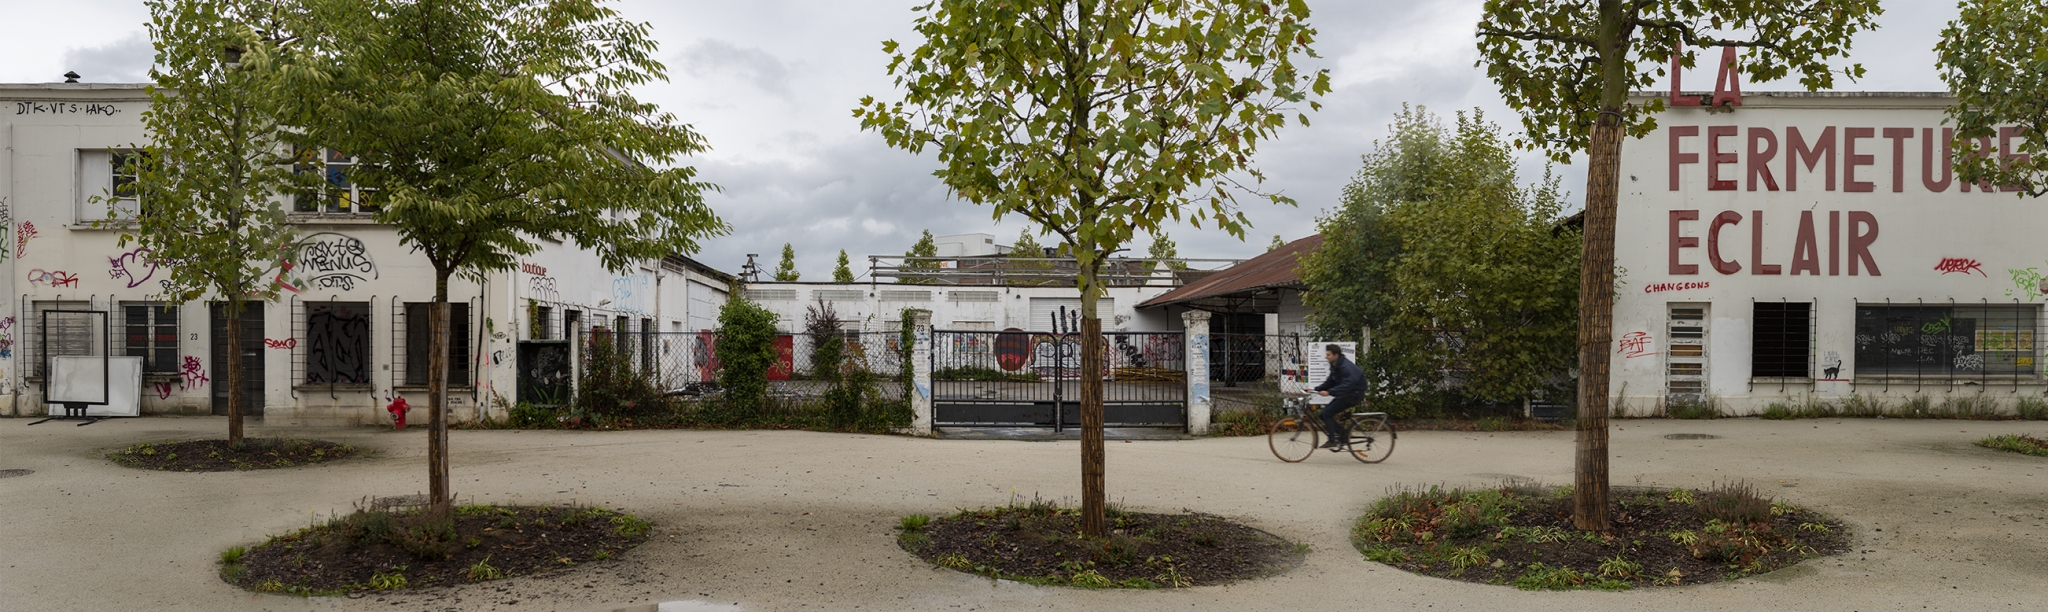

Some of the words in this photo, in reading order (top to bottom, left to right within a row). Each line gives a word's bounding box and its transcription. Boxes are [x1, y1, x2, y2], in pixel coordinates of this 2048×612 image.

[1670, 40, 1742, 106] LA
[1669, 126, 2031, 193] FERMETURE
[1669, 210, 1881, 276] ECLAIR
[522, 258, 547, 277] boutique
[1644, 281, 1710, 293] CHANGEONS
[916, 324, 925, 332] 23
